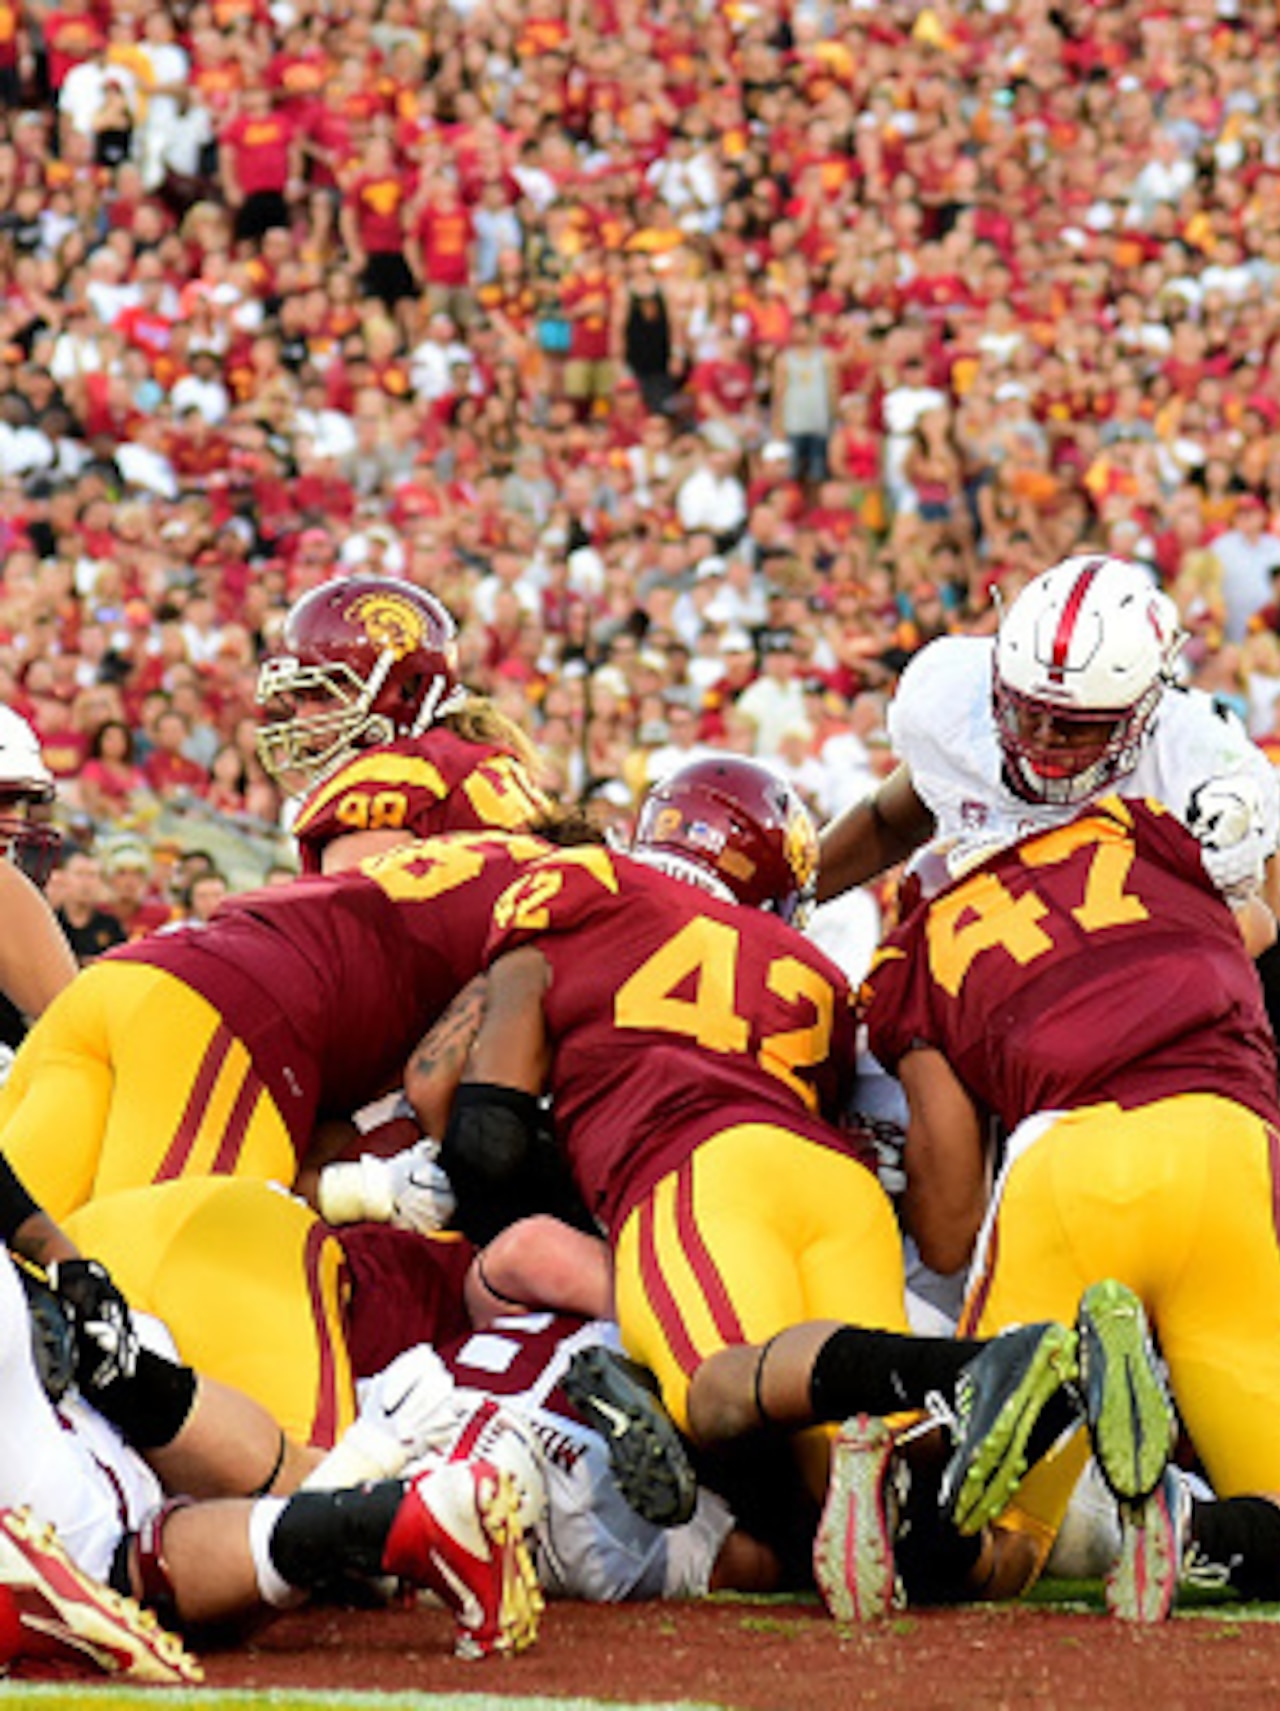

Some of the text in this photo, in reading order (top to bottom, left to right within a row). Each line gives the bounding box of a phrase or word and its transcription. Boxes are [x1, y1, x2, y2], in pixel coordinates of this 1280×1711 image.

[494, 870, 563, 929] 42
[925, 816, 1149, 998] 47
[613, 914, 835, 1117] 42
